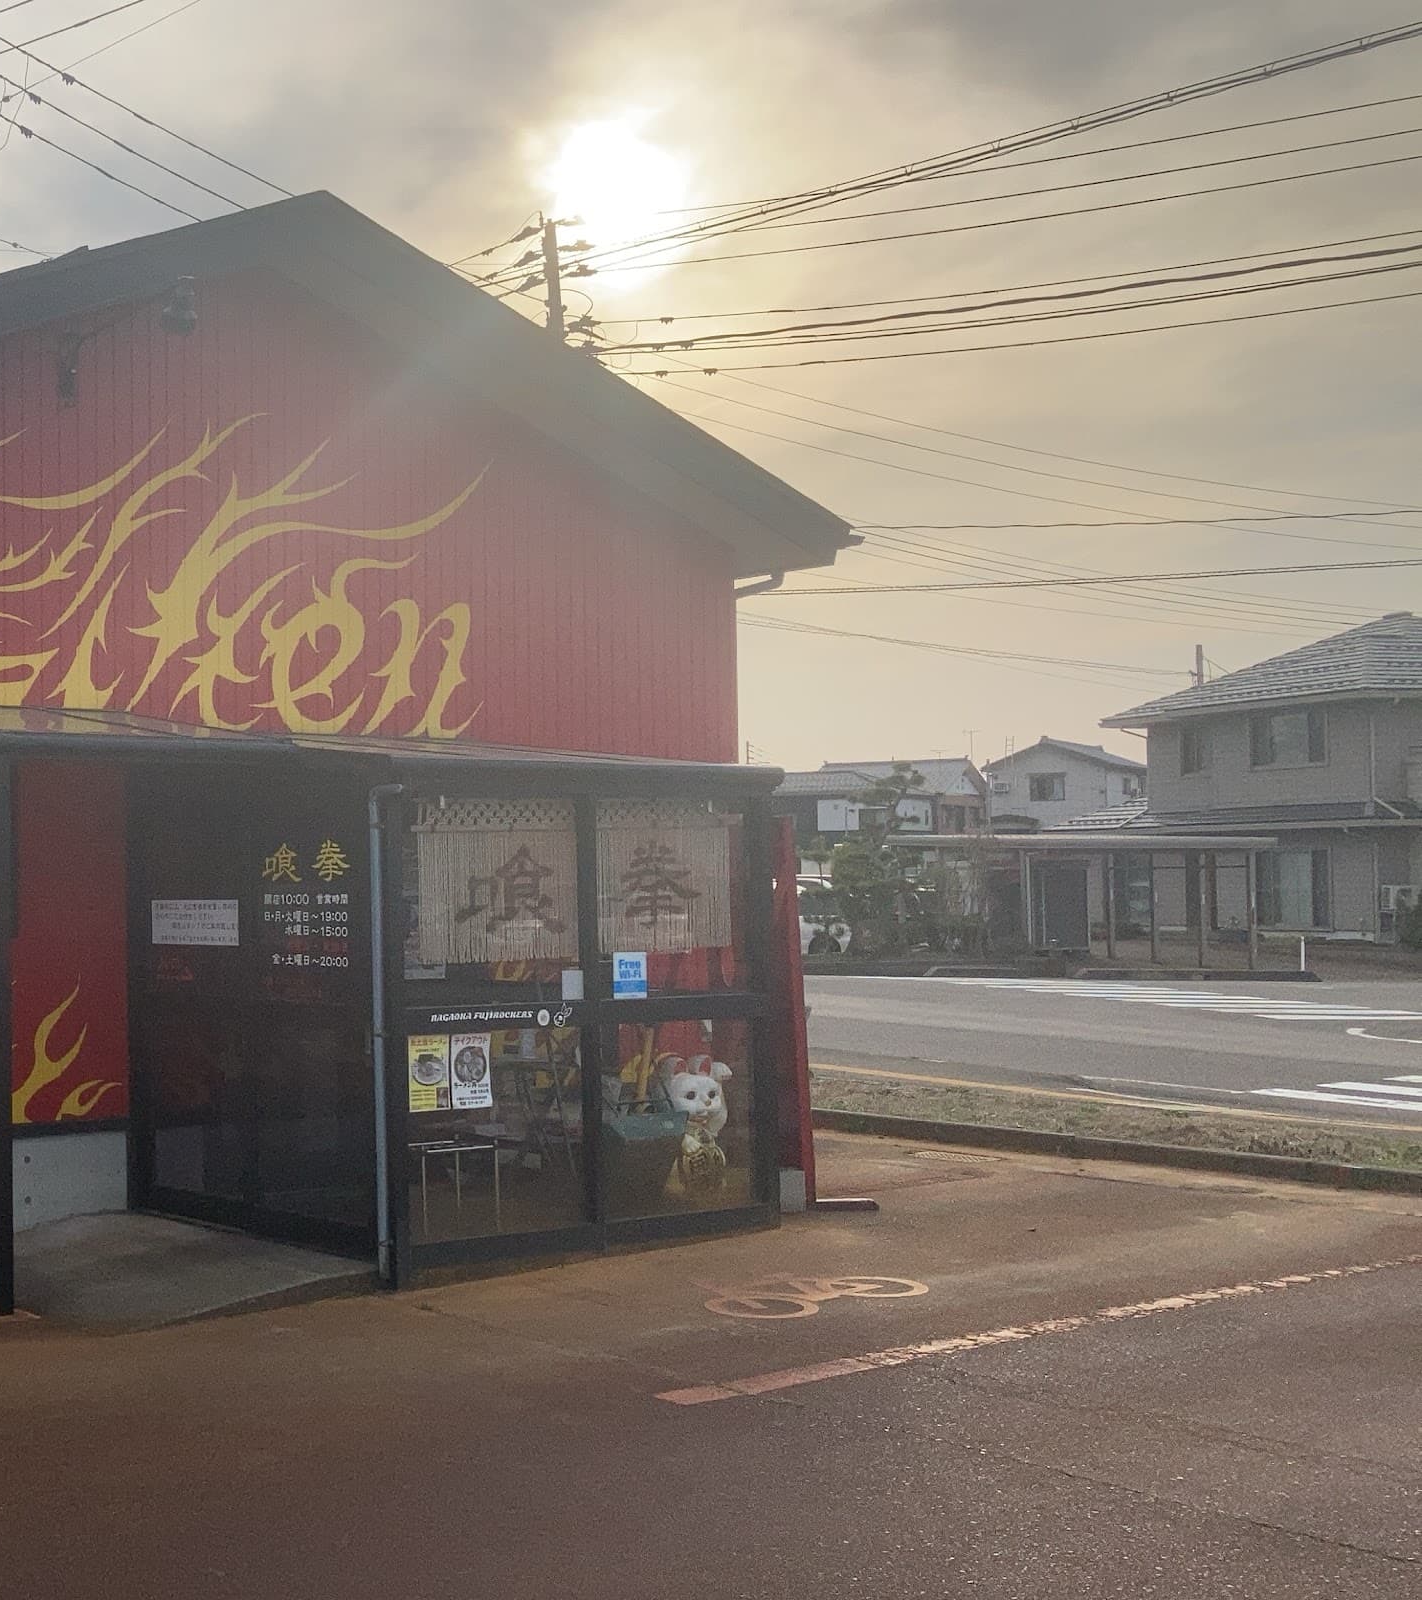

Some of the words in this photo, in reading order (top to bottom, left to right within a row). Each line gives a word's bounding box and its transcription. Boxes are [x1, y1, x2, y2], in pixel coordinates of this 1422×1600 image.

[619, 959, 641, 969] Free
[453, 1035, 488, 1044] テイクアウト
